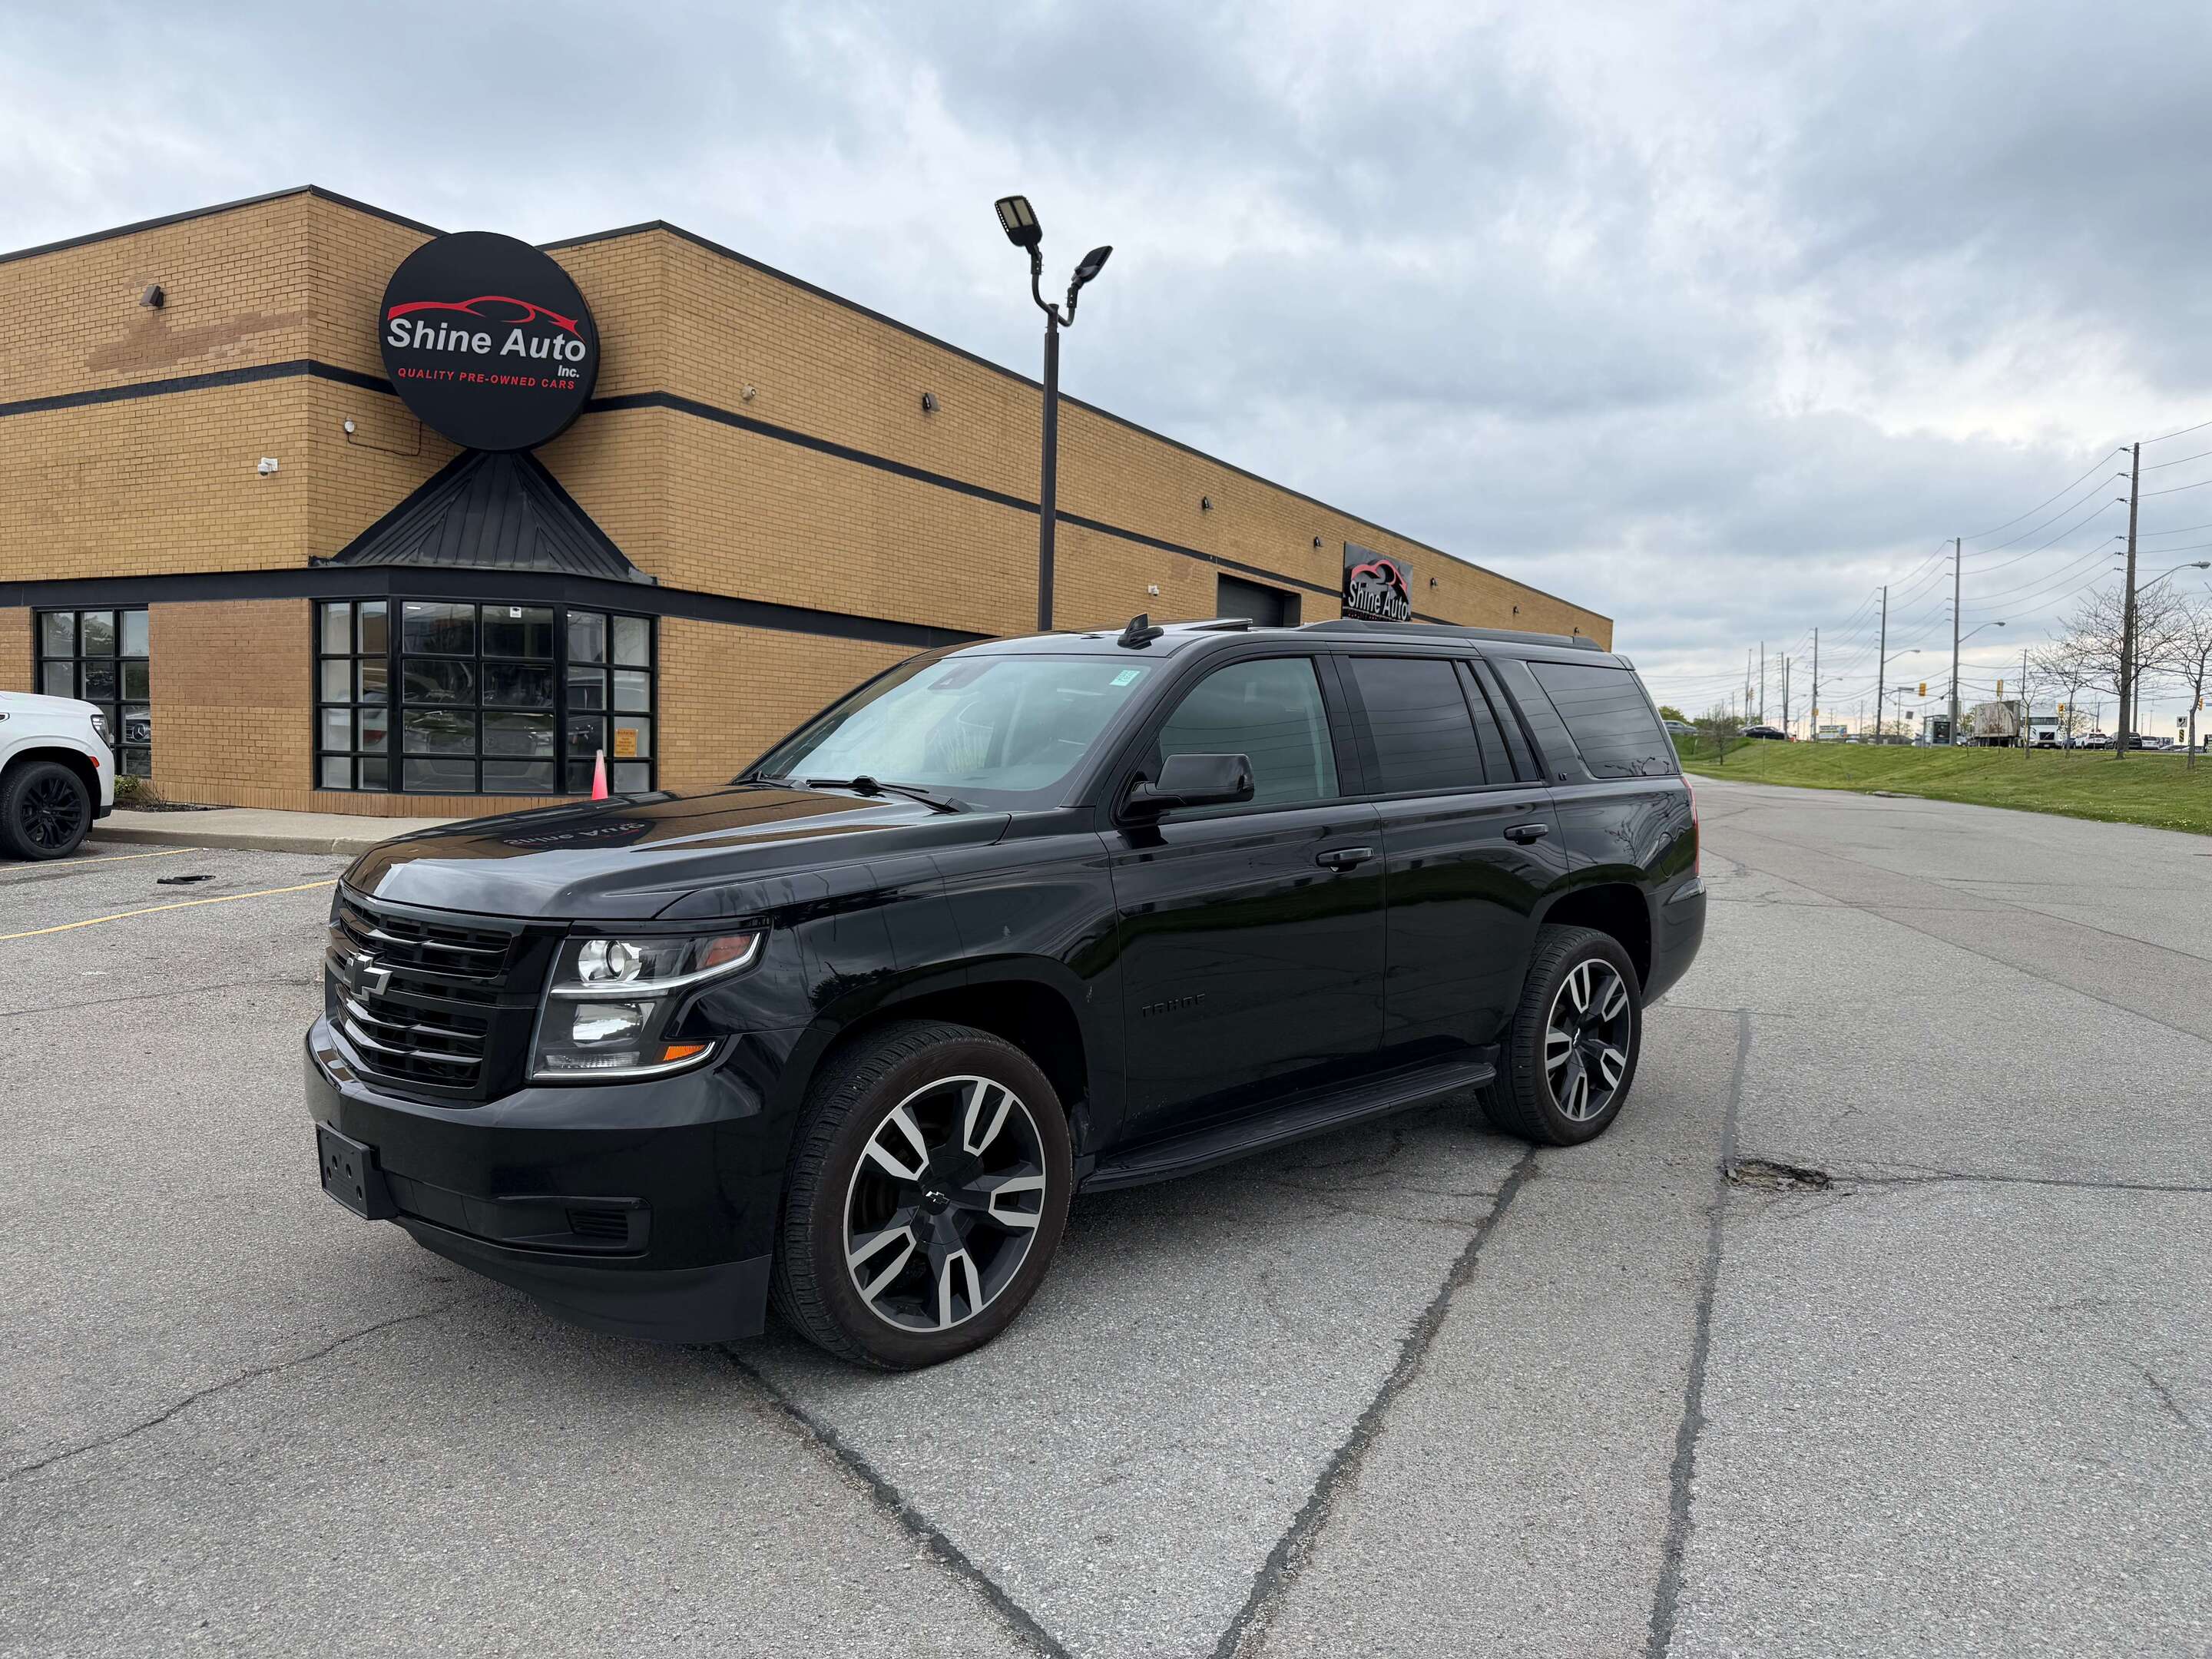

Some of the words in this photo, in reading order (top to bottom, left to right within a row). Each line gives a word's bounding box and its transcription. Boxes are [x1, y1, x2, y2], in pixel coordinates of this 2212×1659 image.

[387, 319, 492, 354] Shine
[499, 328, 586, 362] Auto
[398, 368, 455, 381] QUALITY
[459, 373, 535, 387] PRE-OWNED
[541, 379, 575, 389] CARS
[558, 365, 580, 378] Inc.
[1348, 580, 1381, 614] Shine
[1382, 591, 1408, 621] Auto
